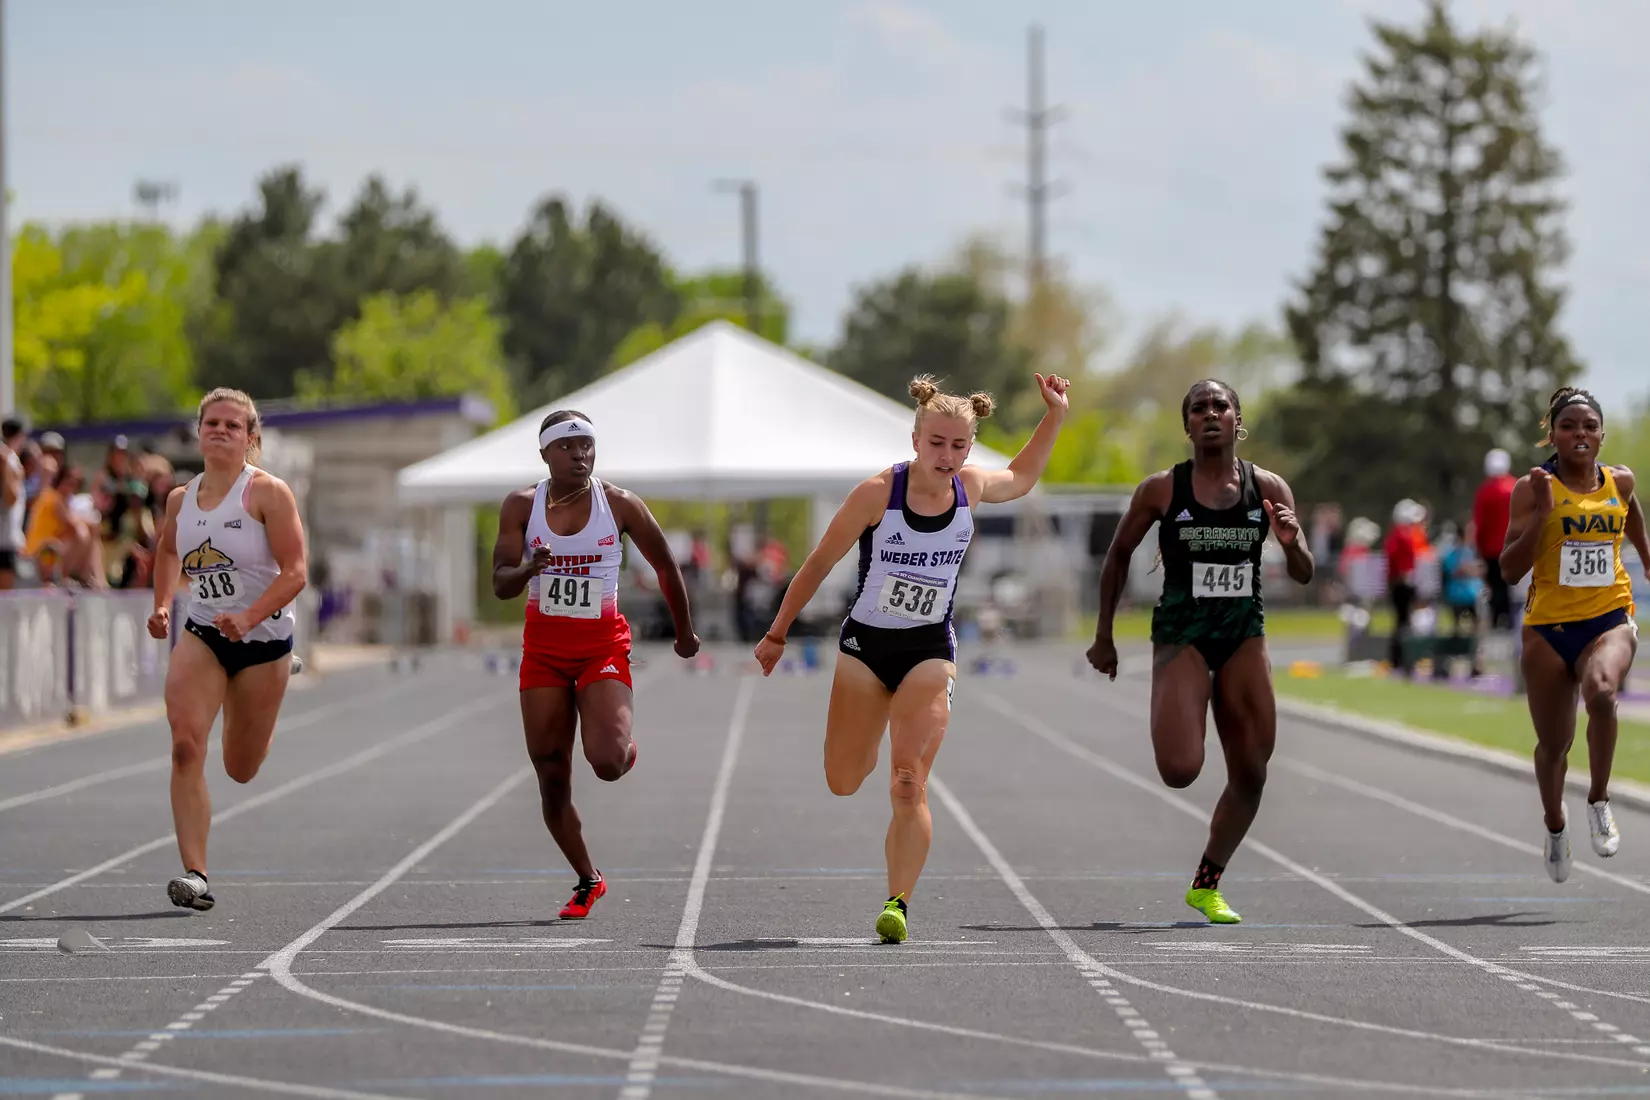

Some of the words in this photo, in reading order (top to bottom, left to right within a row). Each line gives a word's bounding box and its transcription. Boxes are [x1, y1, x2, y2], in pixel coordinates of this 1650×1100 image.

[1179, 527, 1260, 541] SACRAMENTO
[1560, 514, 1623, 535] NAU
[880, 549, 928, 567] WEBER
[930, 548, 964, 567] STATE
[1188, 540, 1253, 552] STATE
[1569, 548, 1607, 575] 356
[199, 572, 235, 599] 318
[548, 577, 591, 607] 491
[1202, 566, 1246, 592] 445
[889, 580, 938, 616] 538
